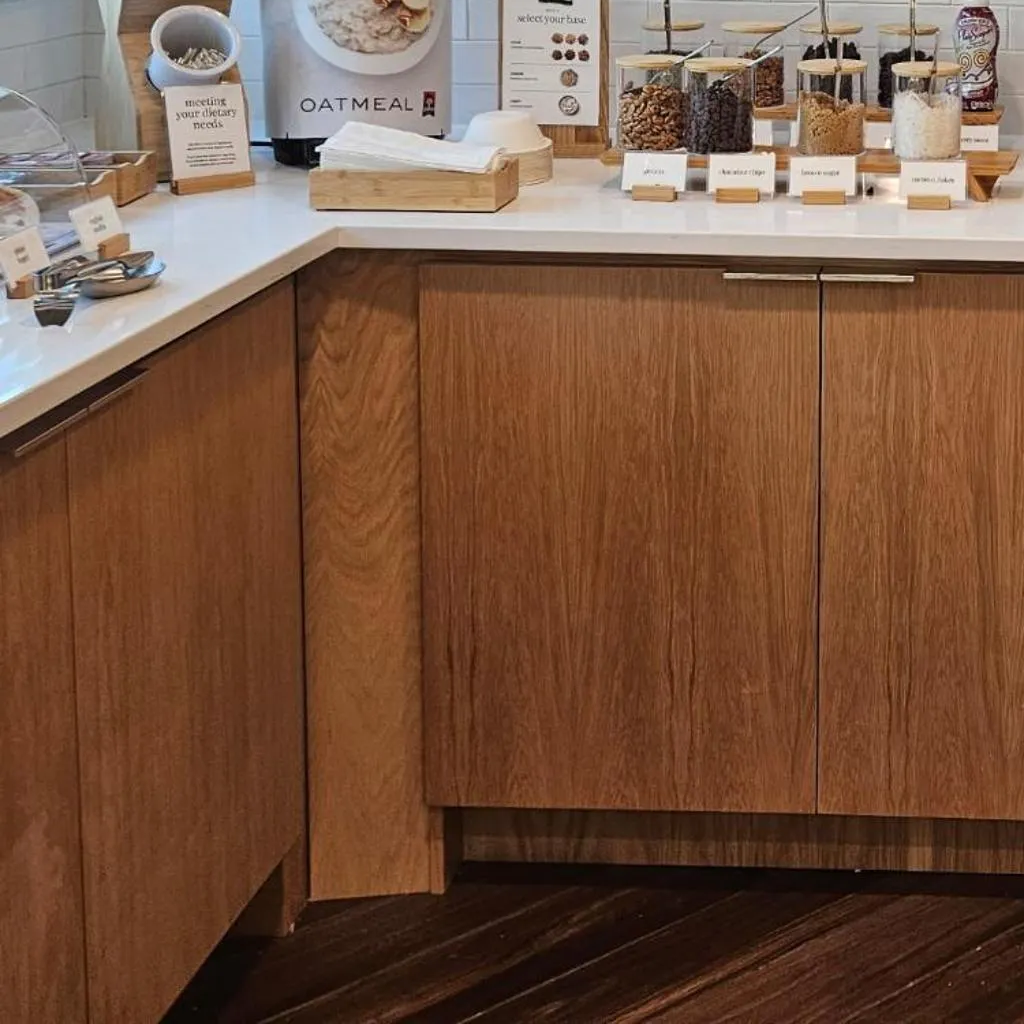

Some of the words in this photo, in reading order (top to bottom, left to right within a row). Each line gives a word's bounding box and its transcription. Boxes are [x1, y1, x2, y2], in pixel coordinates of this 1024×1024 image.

[517, 14, 543, 23] select
[544, 16, 564, 25] your
[185, 97, 227, 107] meeting
[300, 97, 413, 112] OATMEAL
[175, 110, 200, 121] your
[202, 108, 236, 118] dietary
[193, 119, 224, 129] needs
